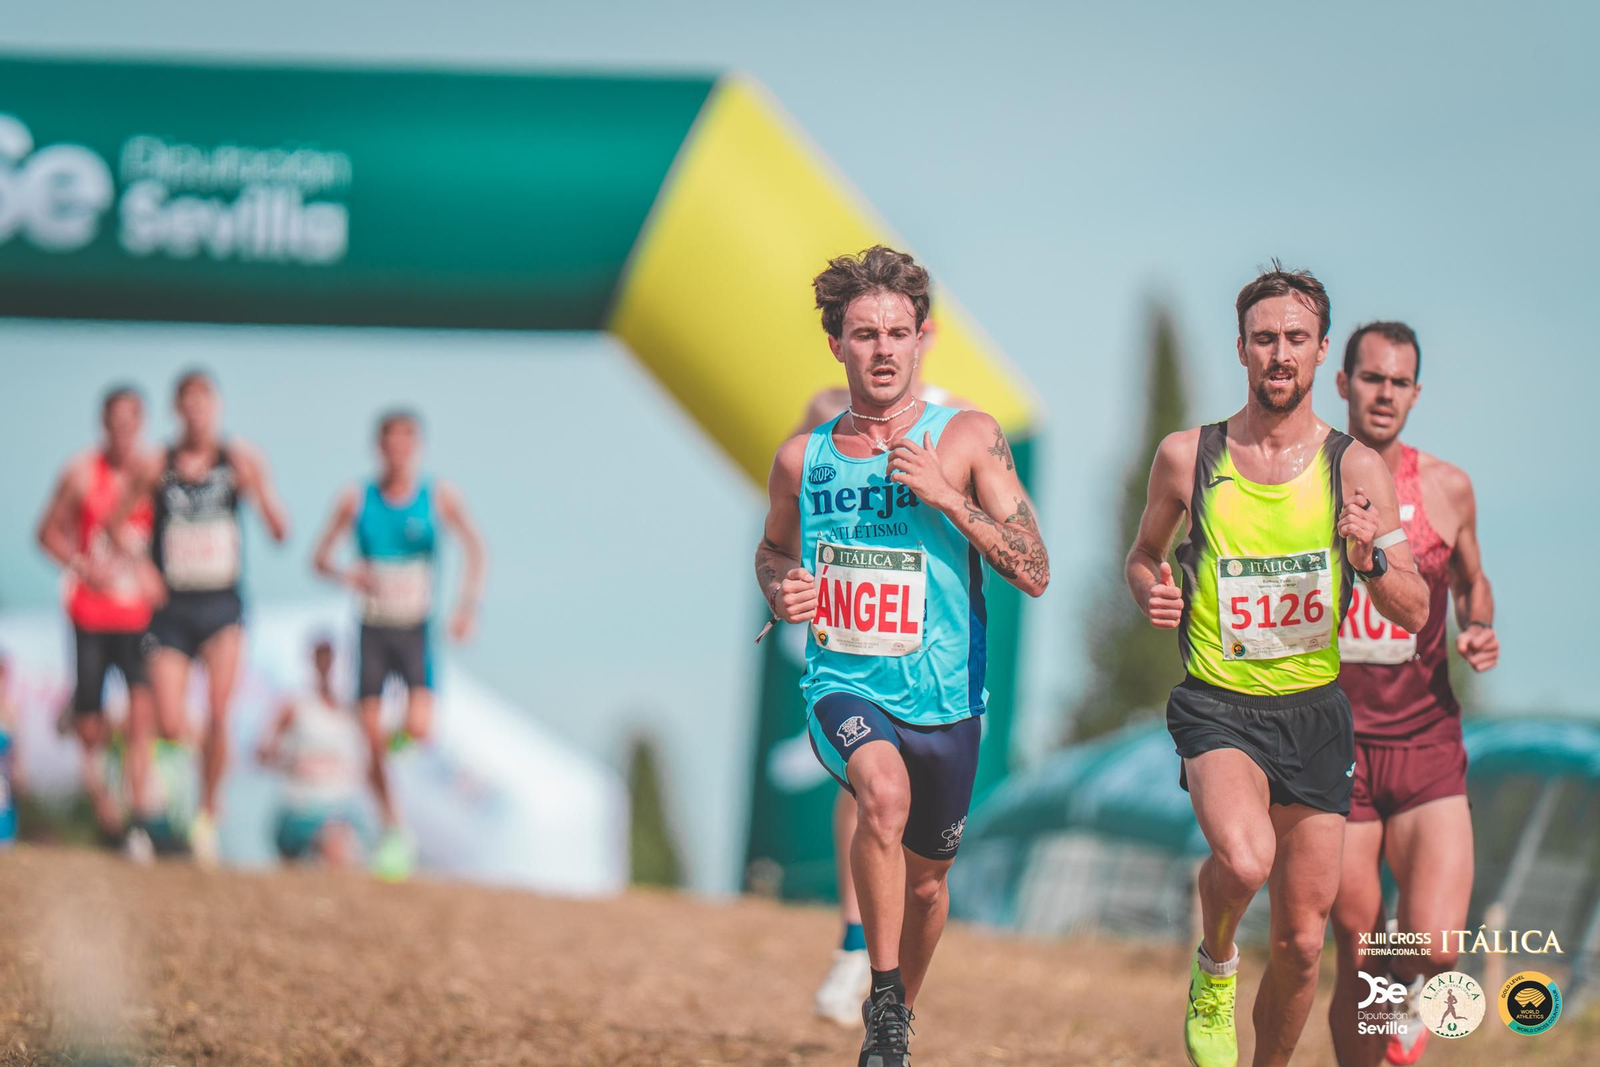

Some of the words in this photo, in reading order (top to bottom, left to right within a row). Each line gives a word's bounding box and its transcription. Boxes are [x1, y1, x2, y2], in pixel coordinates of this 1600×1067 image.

[119, 182, 350, 264] Sevilla
[811, 474, 920, 519] nerja
[830, 522, 908, 541] ATLETISMO
[840, 551, 893, 567] ITÁLICA
[1250, 559, 1302, 573] ITÁLICA
[813, 565, 918, 634] ÁNGEL
[1231, 589, 1324, 630] 5126
